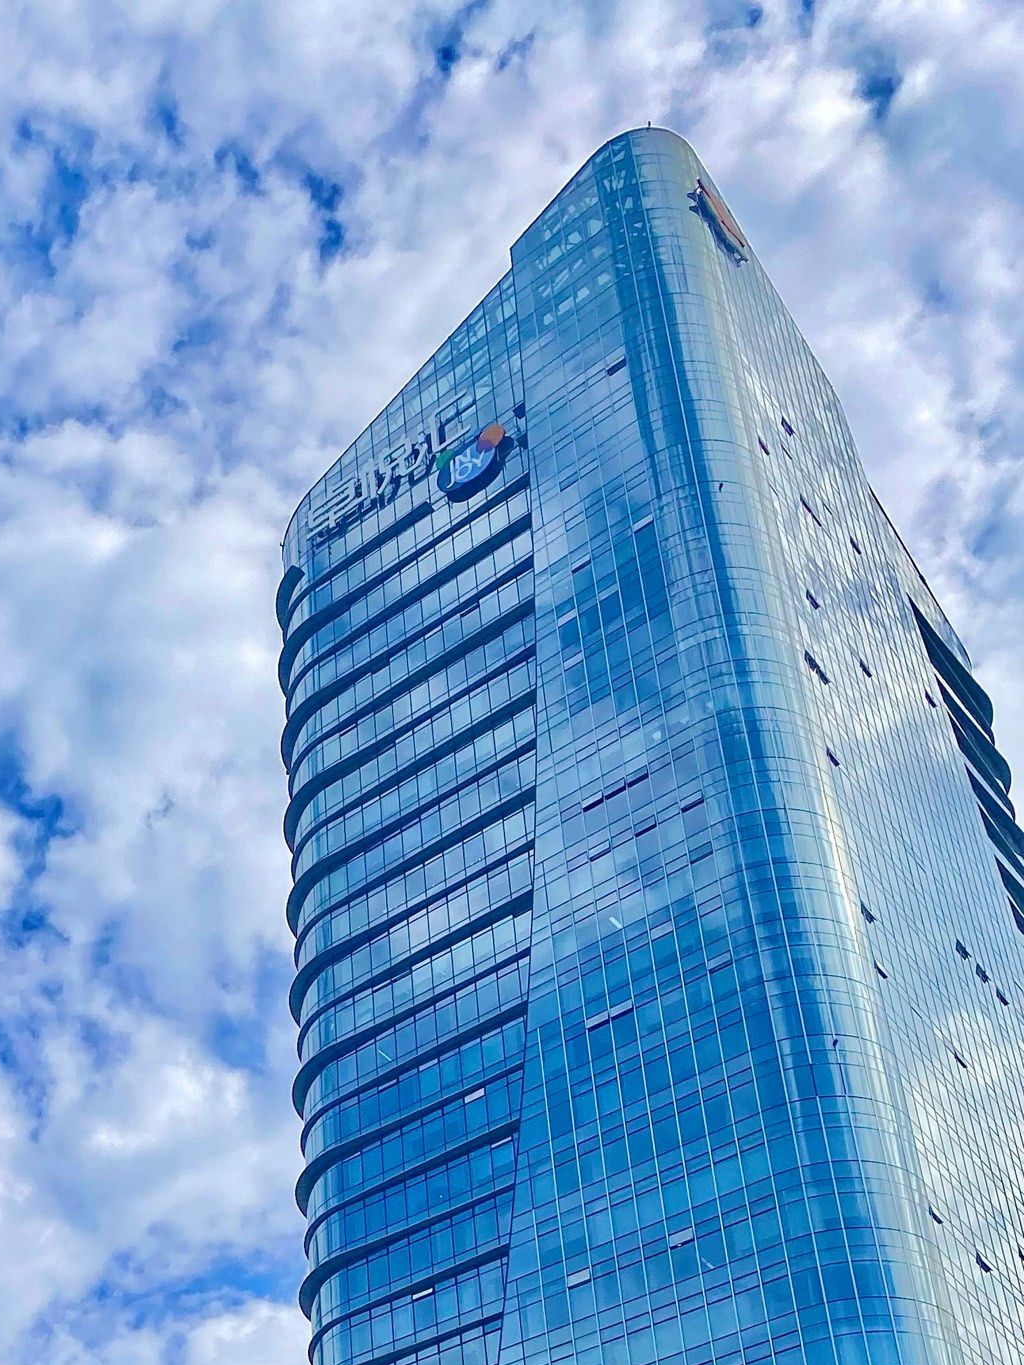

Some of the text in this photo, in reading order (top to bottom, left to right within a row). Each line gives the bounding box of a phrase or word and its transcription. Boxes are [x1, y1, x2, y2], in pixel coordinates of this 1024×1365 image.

[305, 388, 473, 541] 卓悦汇
[446, 449, 486, 489] JOY
